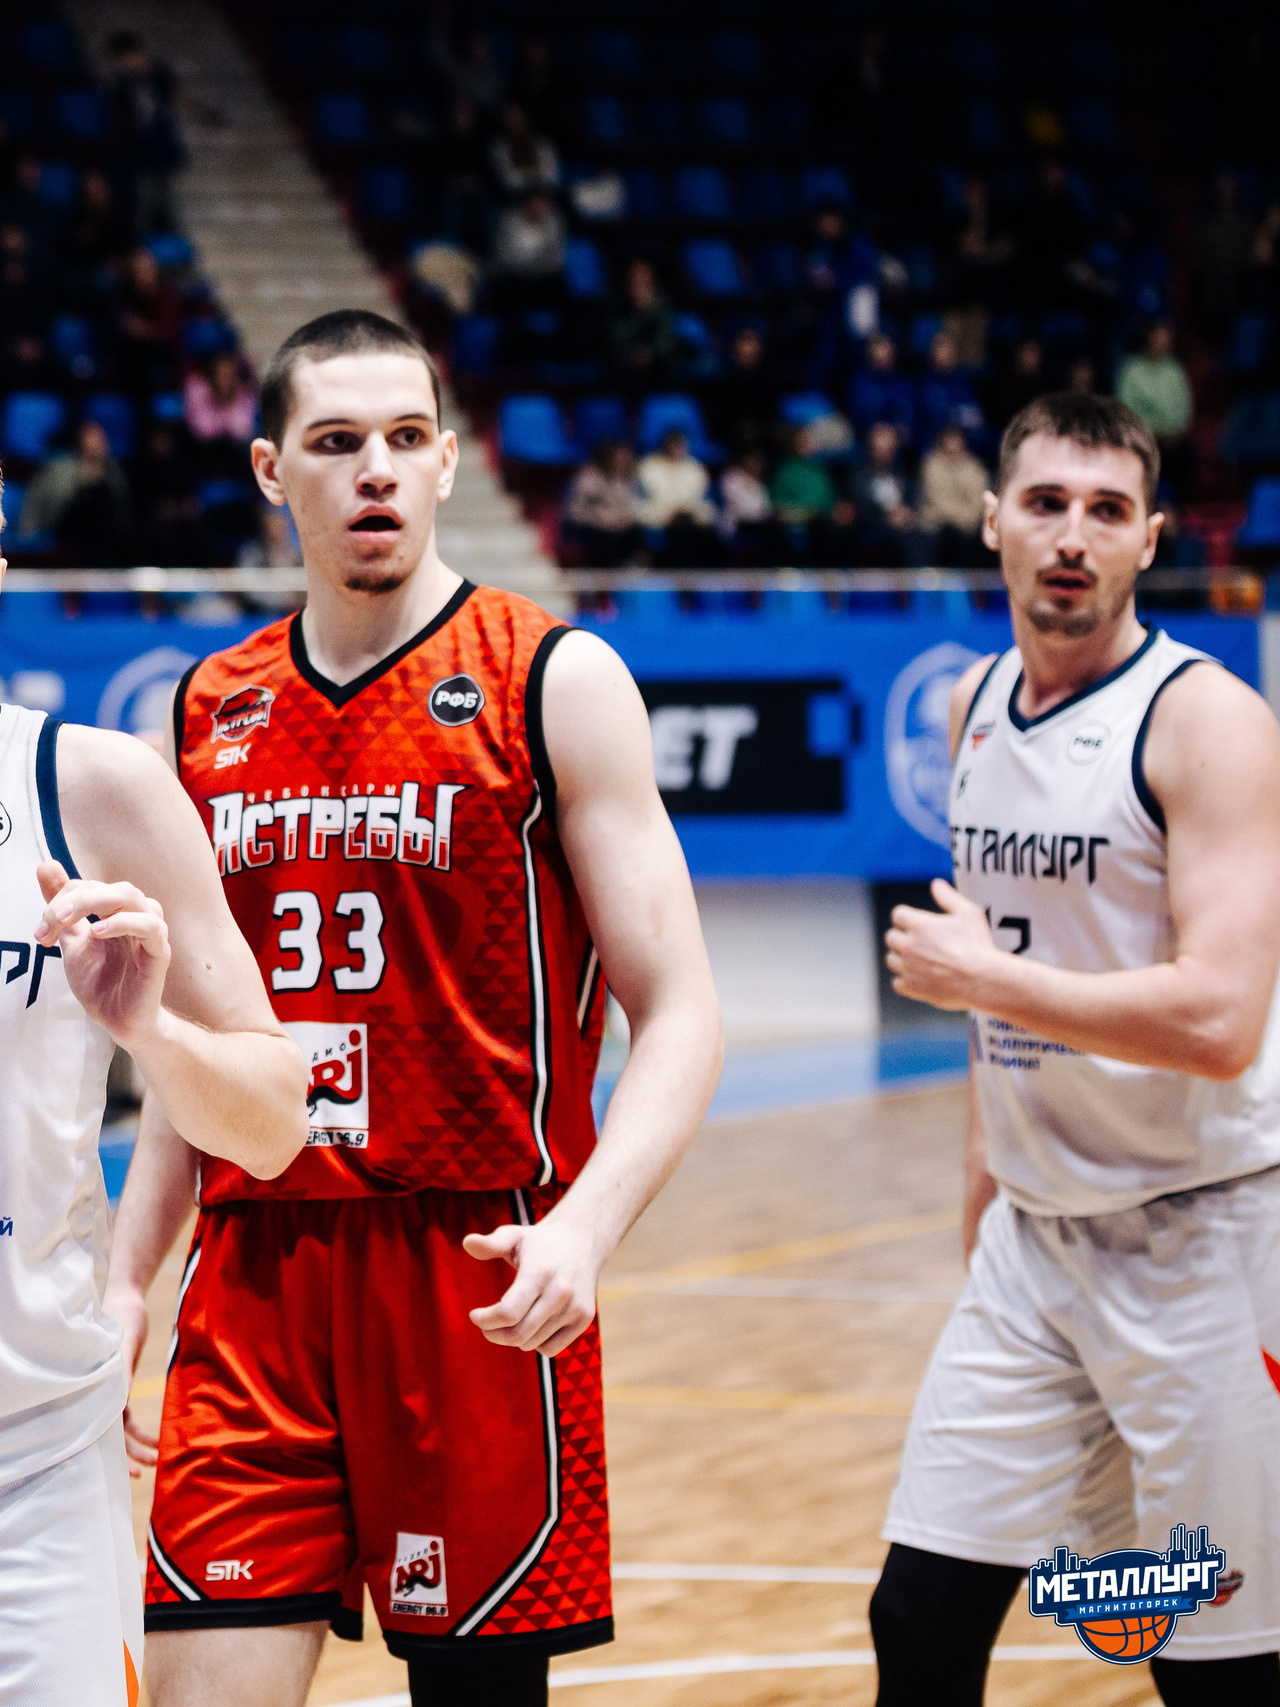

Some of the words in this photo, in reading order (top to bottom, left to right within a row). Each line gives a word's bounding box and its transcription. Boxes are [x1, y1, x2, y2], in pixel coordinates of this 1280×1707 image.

[436, 691, 479, 708] РФБ
[213, 743, 251, 769] STK
[207, 781, 475, 877] ЯСТРЕБЫ
[271, 890, 386, 994] 33
[205, 1560, 253, 1581] STK
